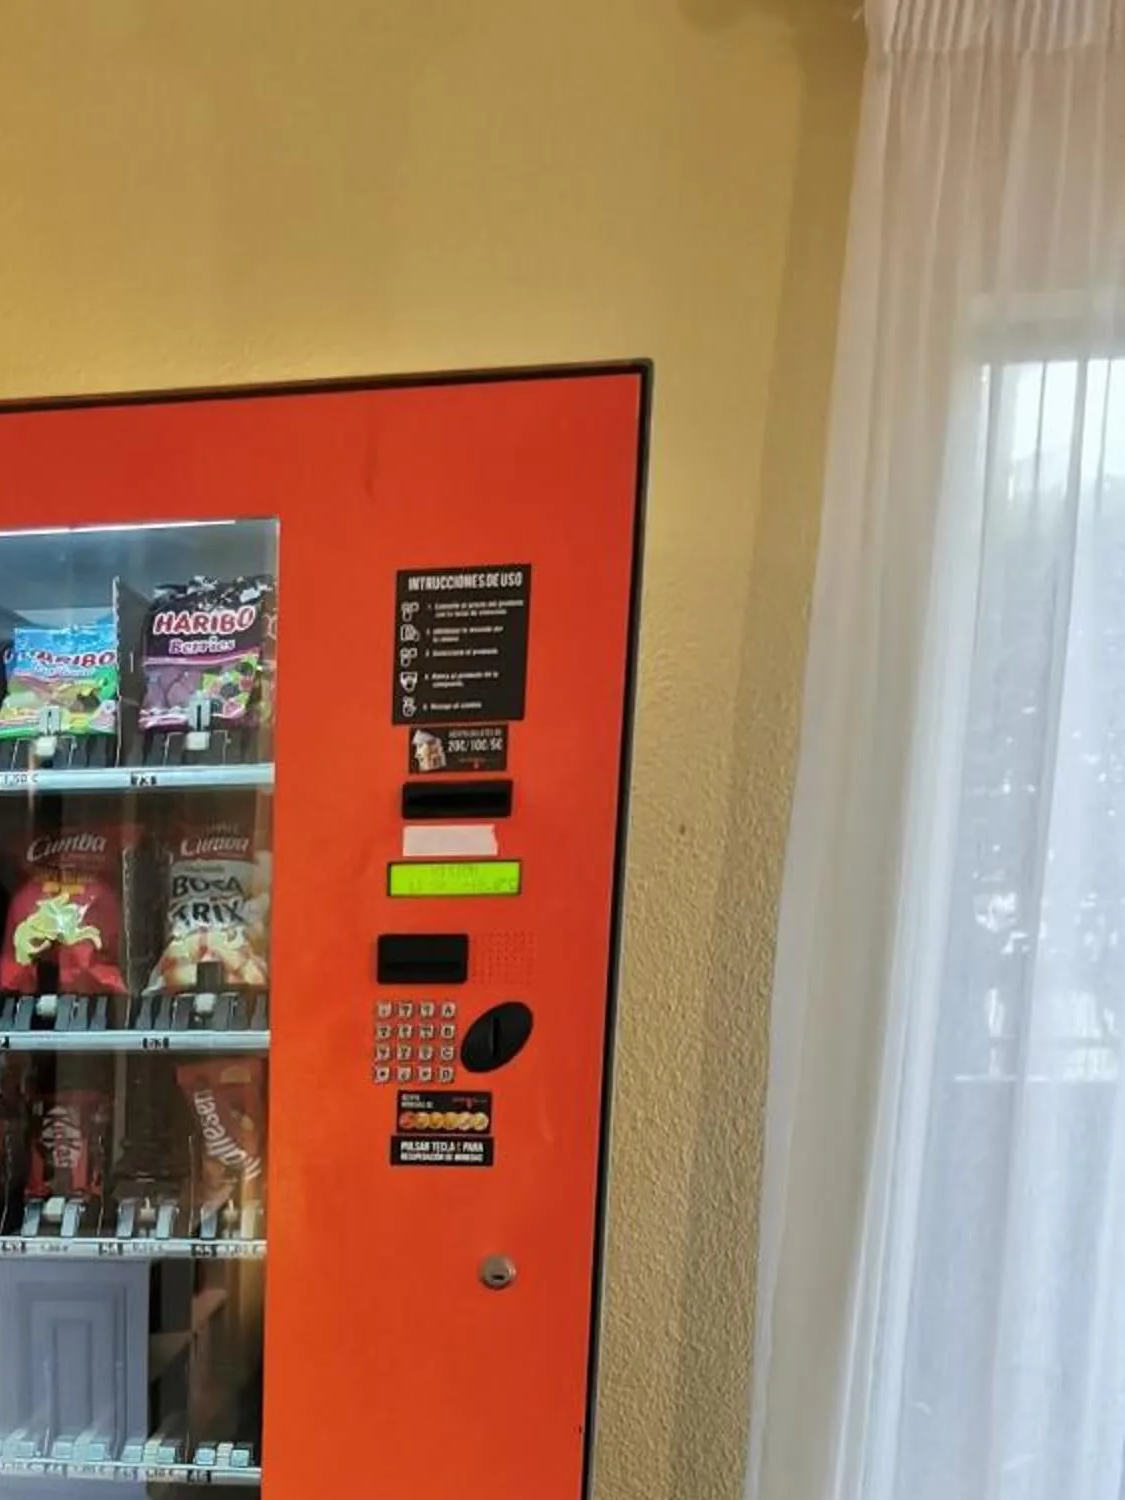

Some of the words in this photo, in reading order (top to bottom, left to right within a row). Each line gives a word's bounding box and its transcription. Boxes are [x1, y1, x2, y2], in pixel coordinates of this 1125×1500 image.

[486, 573, 499, 588] DE
[500, 571, 524, 587] USO
[153, 605, 256, 635] HARIBO
[169, 636, 236, 654] Berries
[26, 832, 107, 861] Cumba
